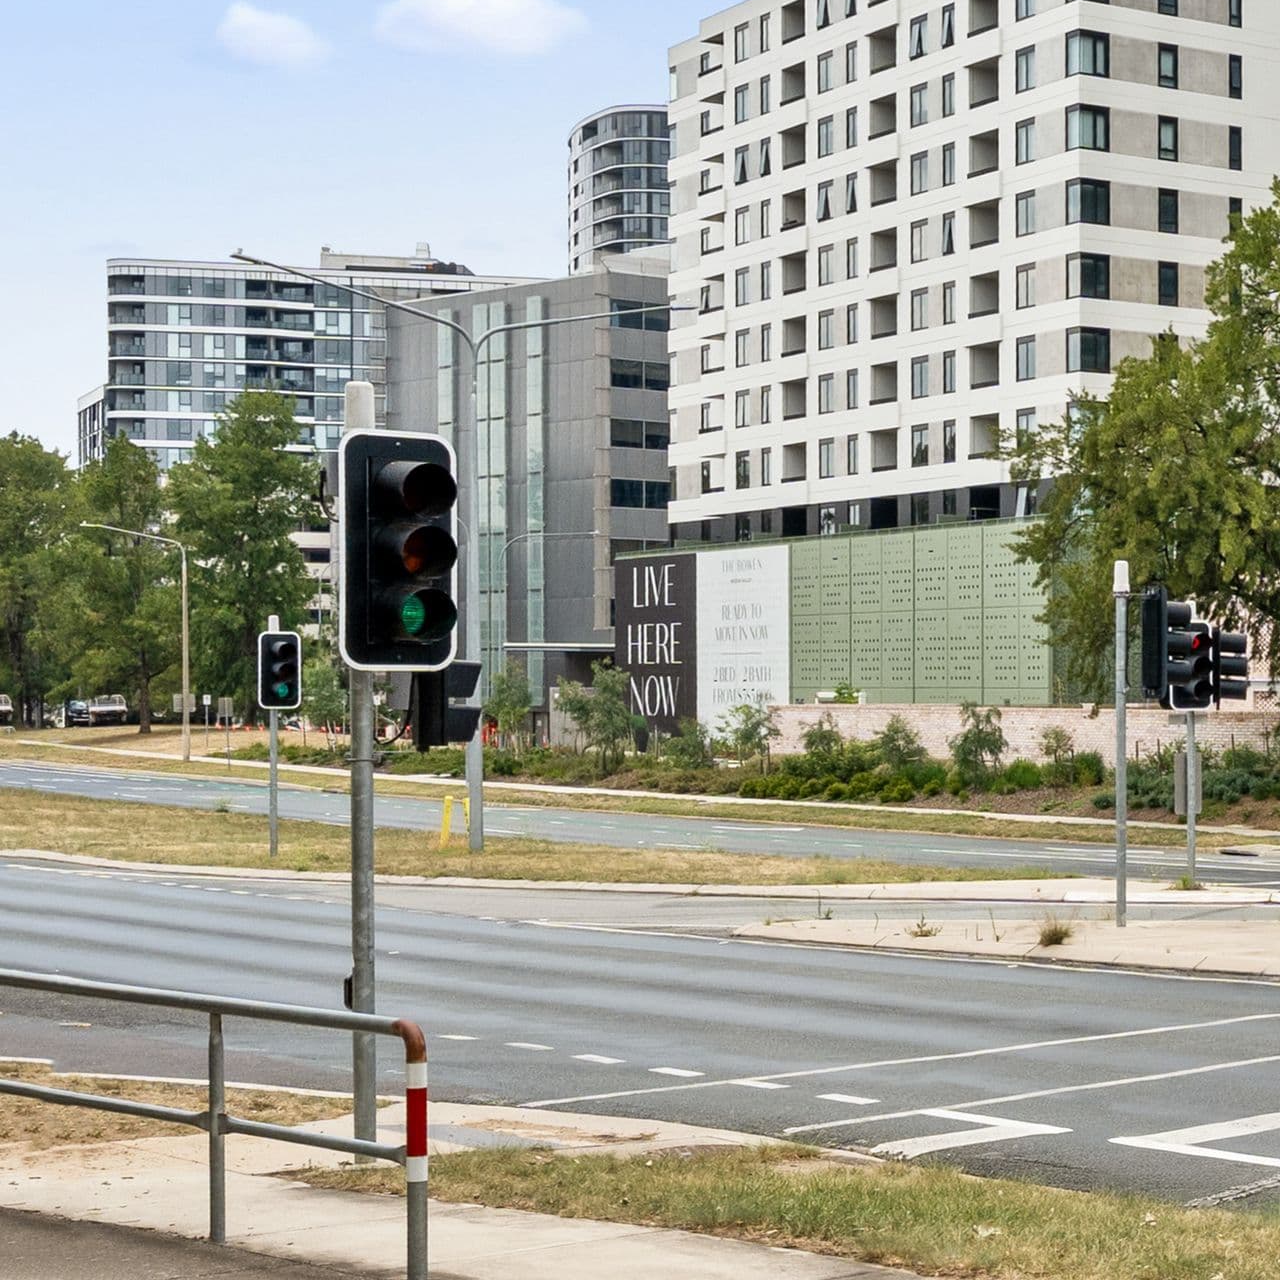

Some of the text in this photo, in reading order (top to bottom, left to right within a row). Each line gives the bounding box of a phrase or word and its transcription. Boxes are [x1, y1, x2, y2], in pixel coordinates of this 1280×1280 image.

[633, 564, 676, 608] LIVE
[627, 622, 683, 665] HERE
[630, 674, 680, 717] NOW
